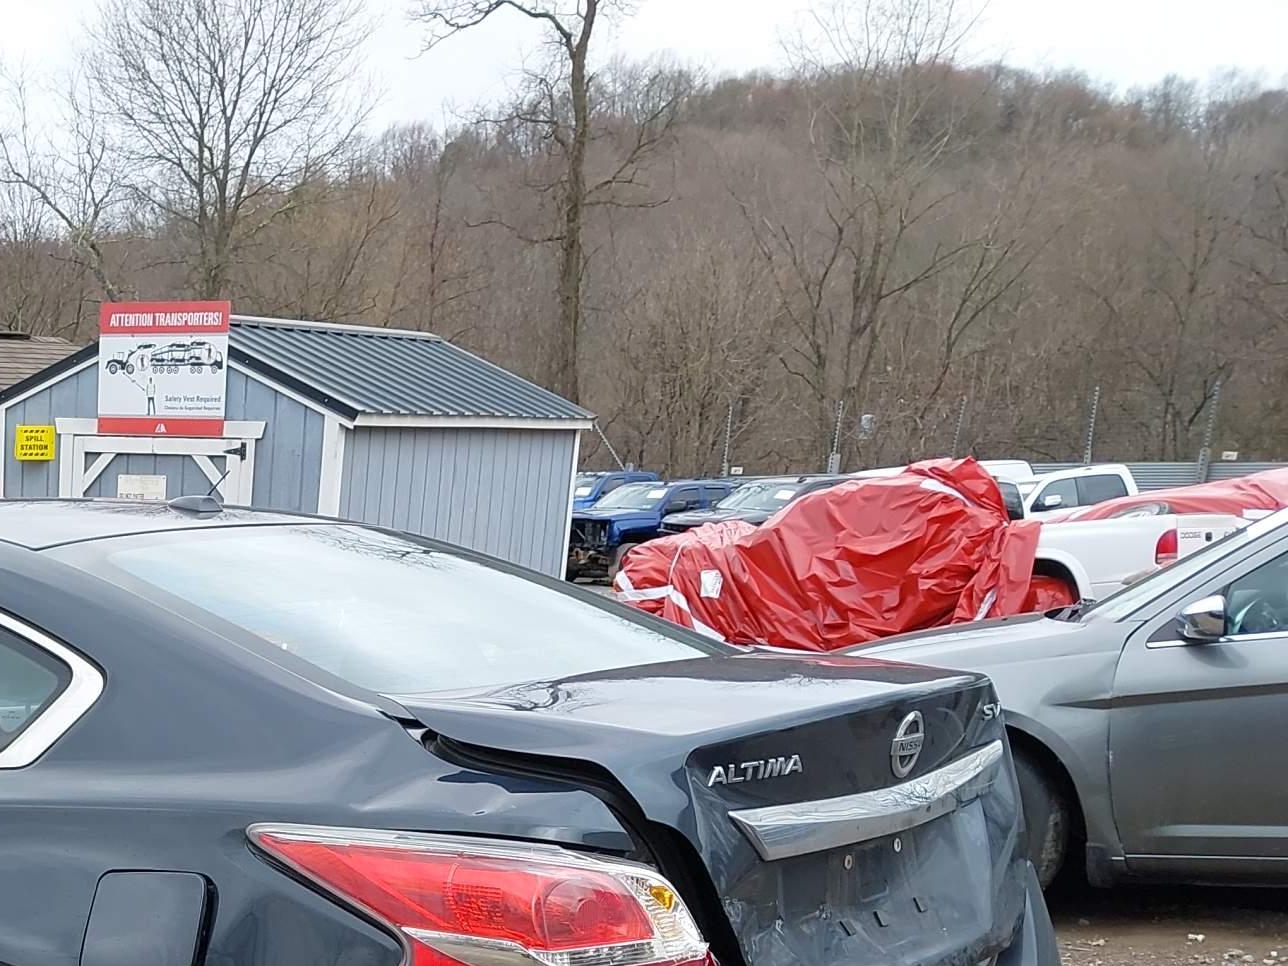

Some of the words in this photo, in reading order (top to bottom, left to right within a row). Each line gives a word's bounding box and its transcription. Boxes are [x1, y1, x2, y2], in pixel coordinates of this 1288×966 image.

[109, 312, 153, 327] ATTENTION
[155, 311, 223, 326] TRANSPORTERS!
[196, 395, 222, 403] Required
[983, 702, 1002, 721] SV
[707, 753, 804, 788] ALTIMA
